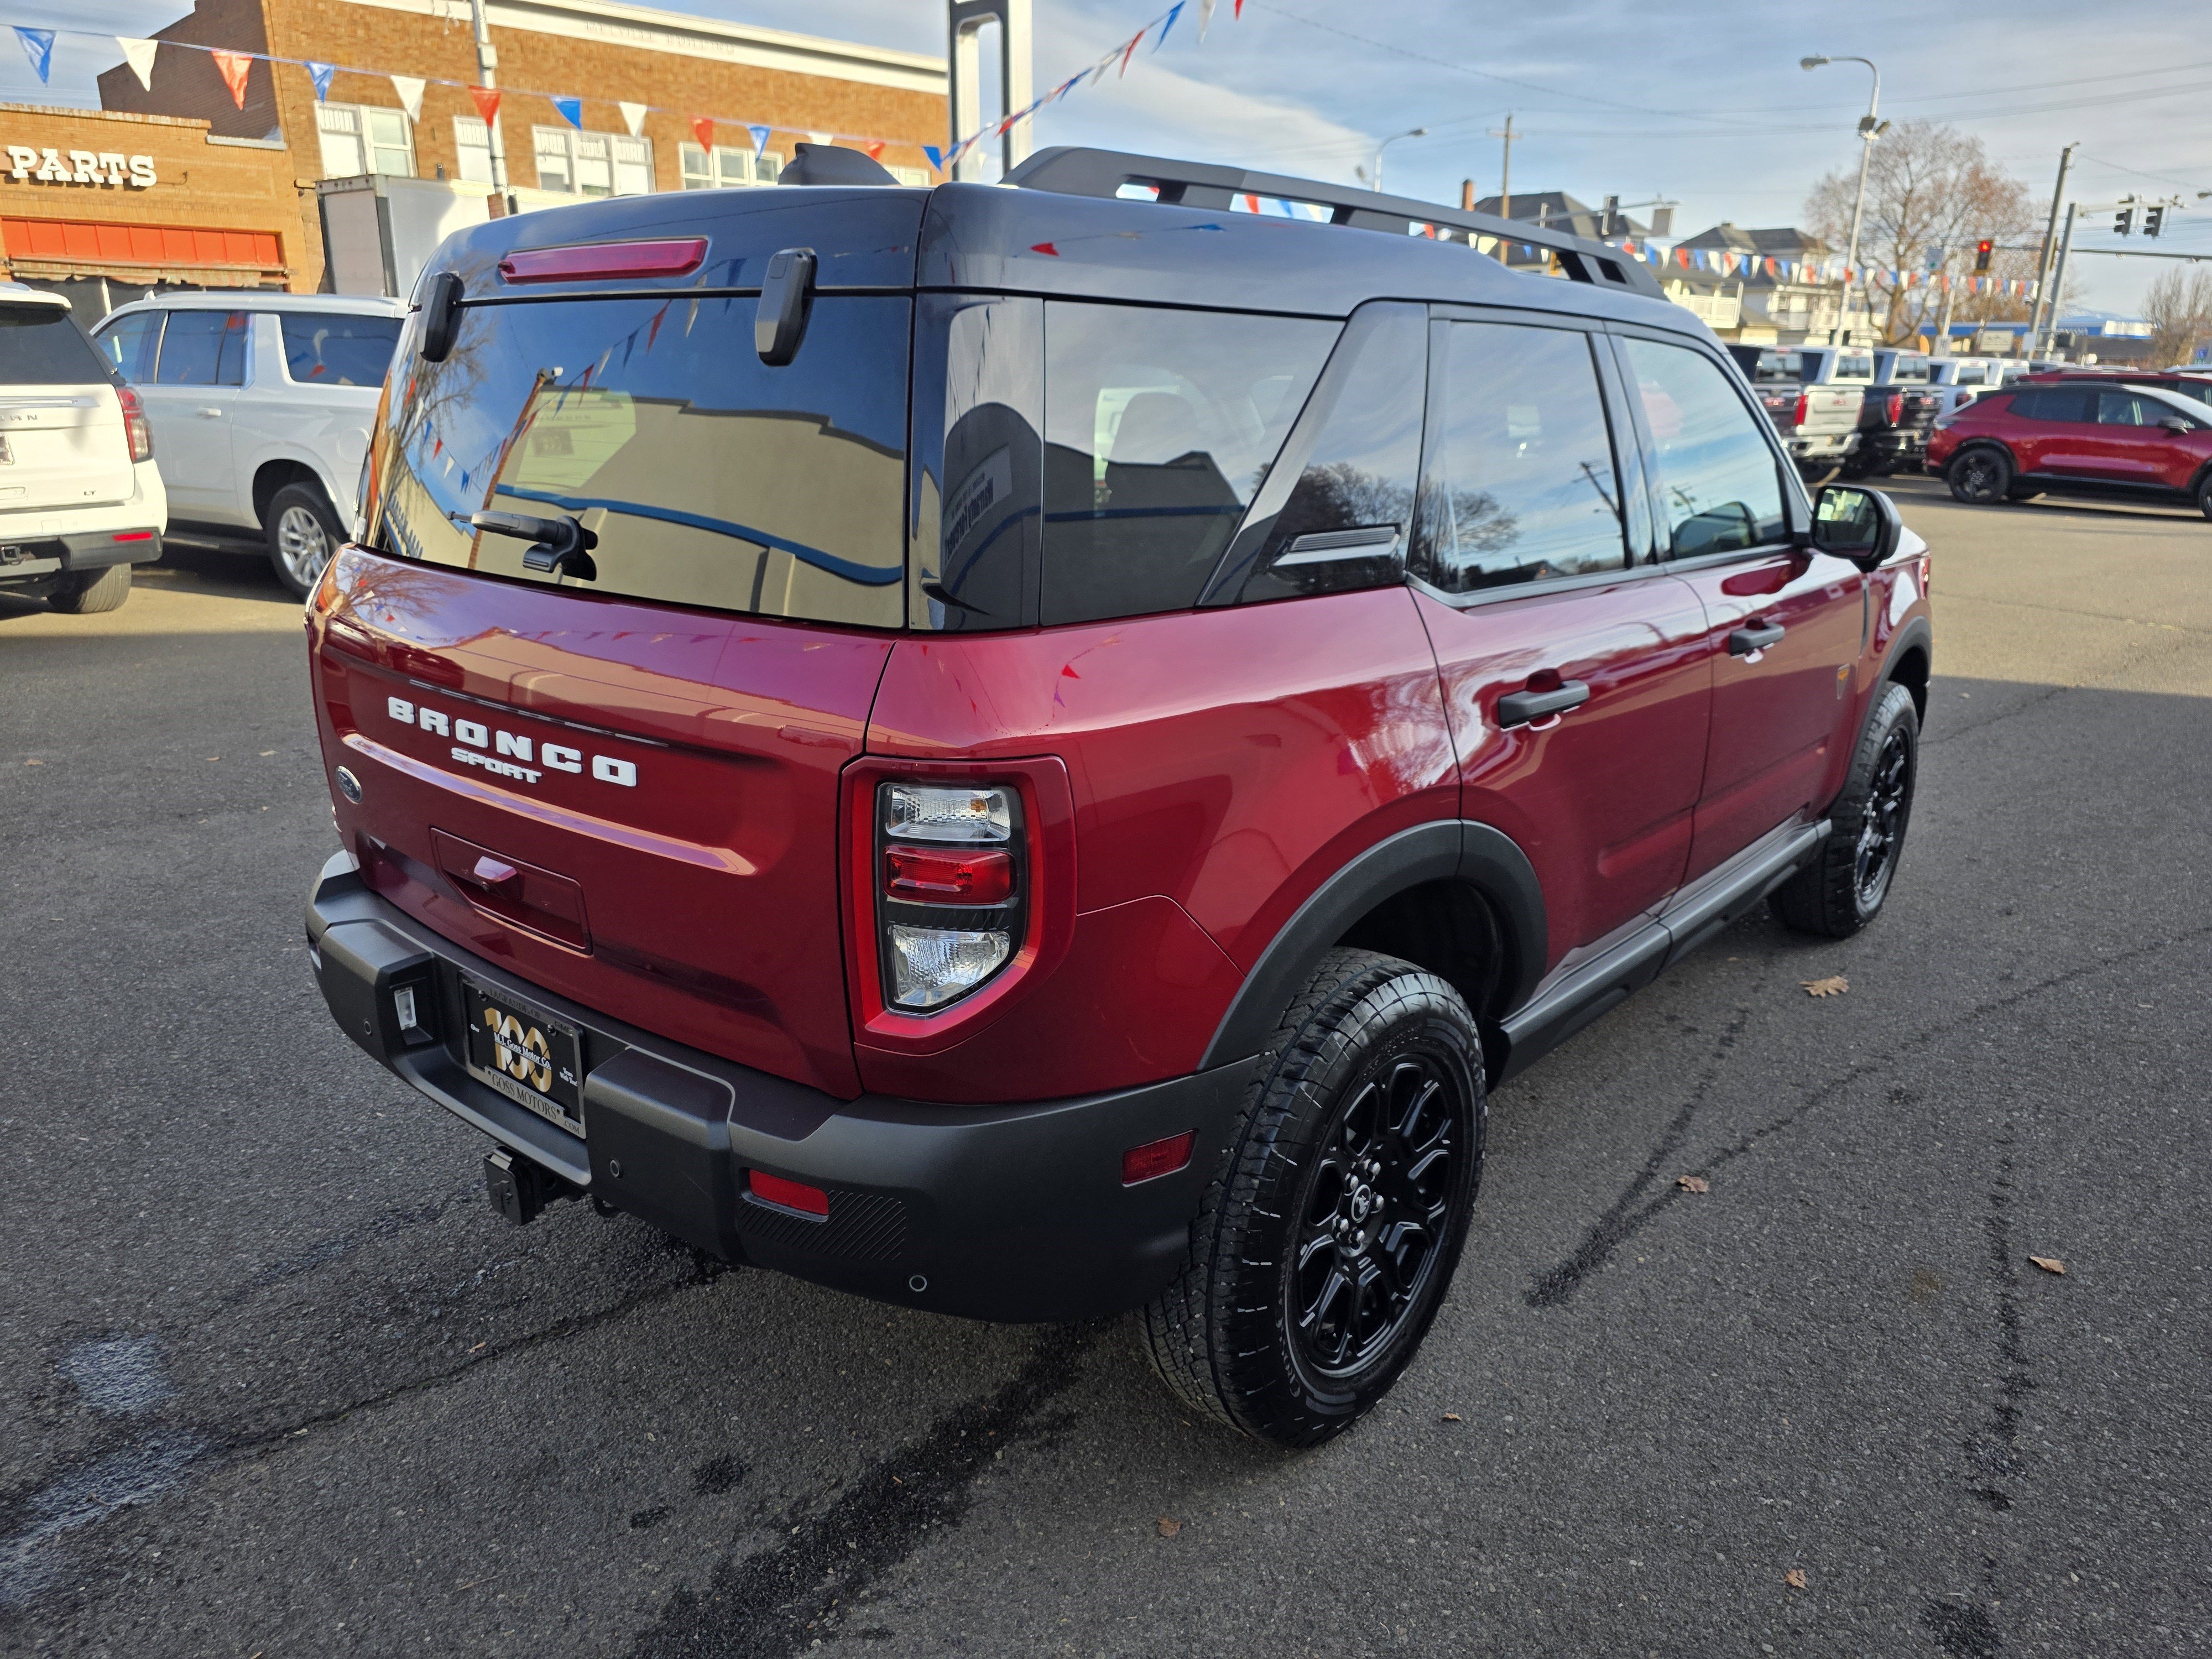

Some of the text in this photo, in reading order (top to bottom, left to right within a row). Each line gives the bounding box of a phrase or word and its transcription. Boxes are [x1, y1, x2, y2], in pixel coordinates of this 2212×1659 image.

[8, 145, 157, 187] PARTS
[388, 696, 637, 787] BRONCO
[451, 747, 542, 784] SPORT
[484, 1007, 552, 1093] 100
[494, 1032, 552, 1069] M.J. Goss Motor Co.
[492, 1073, 557, 1120] GOSS MOTORS
[563, 1120, 580, 1134] .COM
